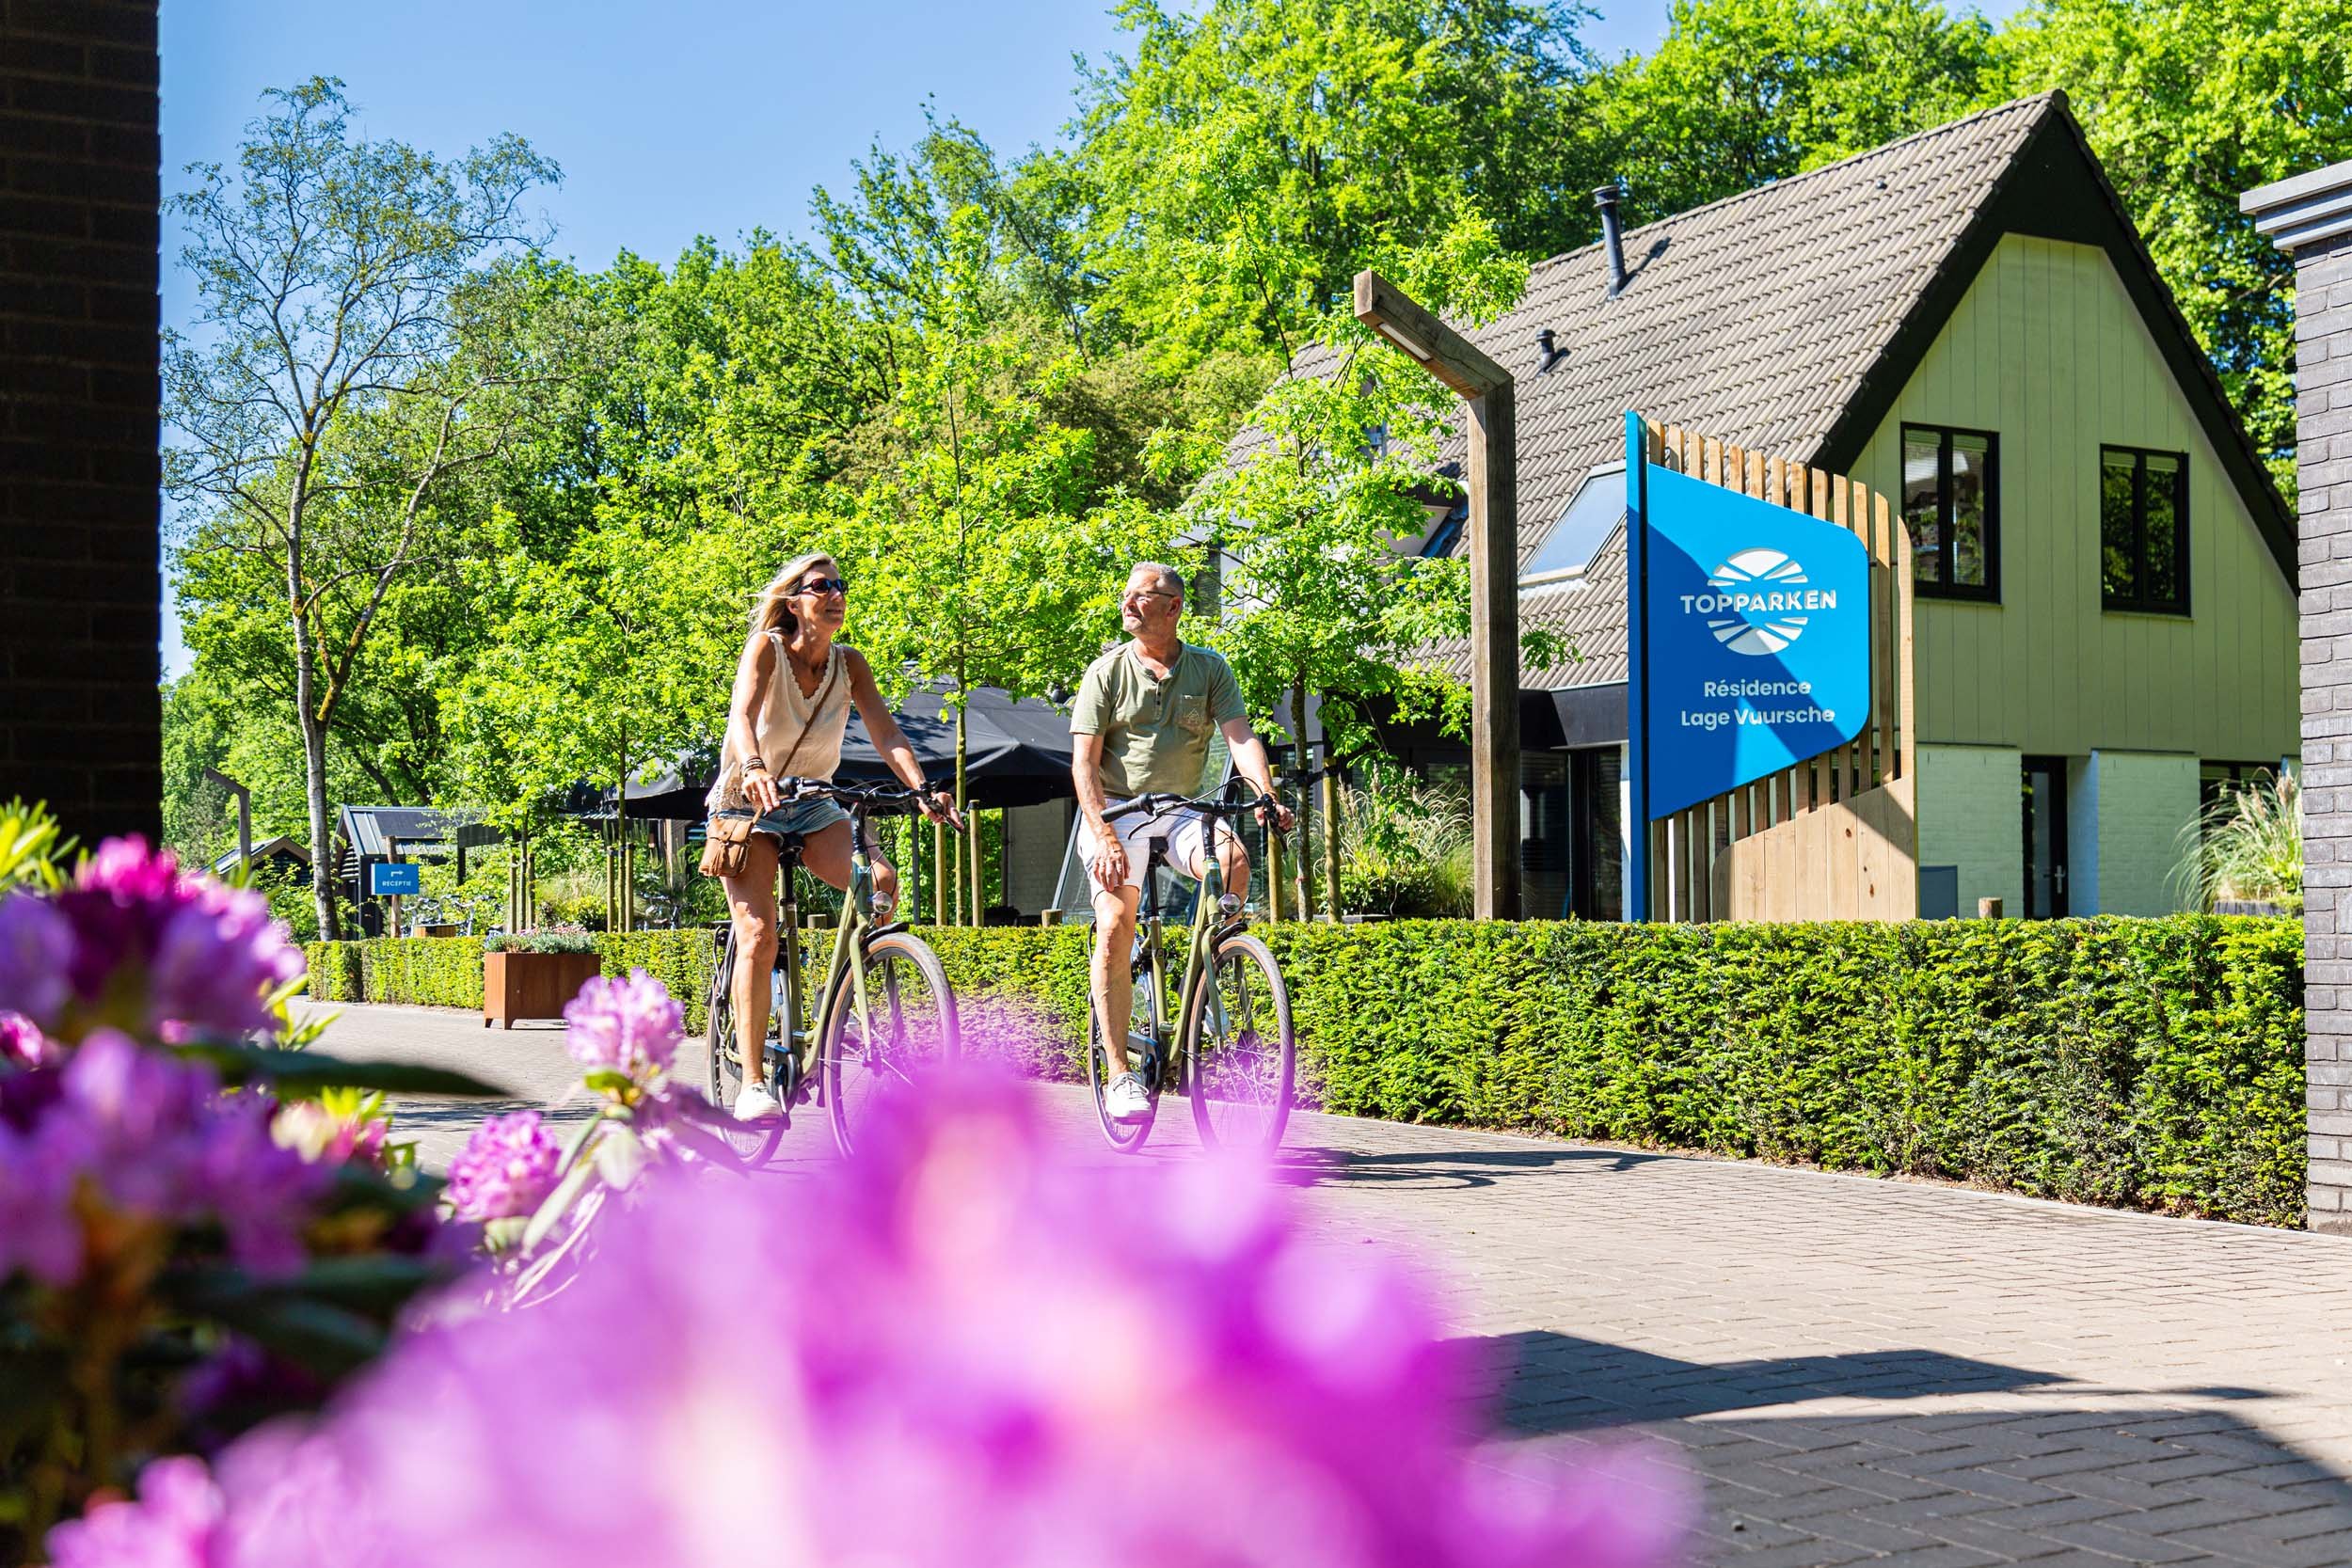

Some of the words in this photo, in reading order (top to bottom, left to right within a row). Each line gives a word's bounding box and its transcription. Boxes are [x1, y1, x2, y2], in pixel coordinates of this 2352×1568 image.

[1680, 590, 1836, 613] TOPPARKEN
[1704, 679, 1811, 697] Résidence
[1681, 710, 1729, 731] Lage
[1734, 706, 1835, 725] Vuursche
